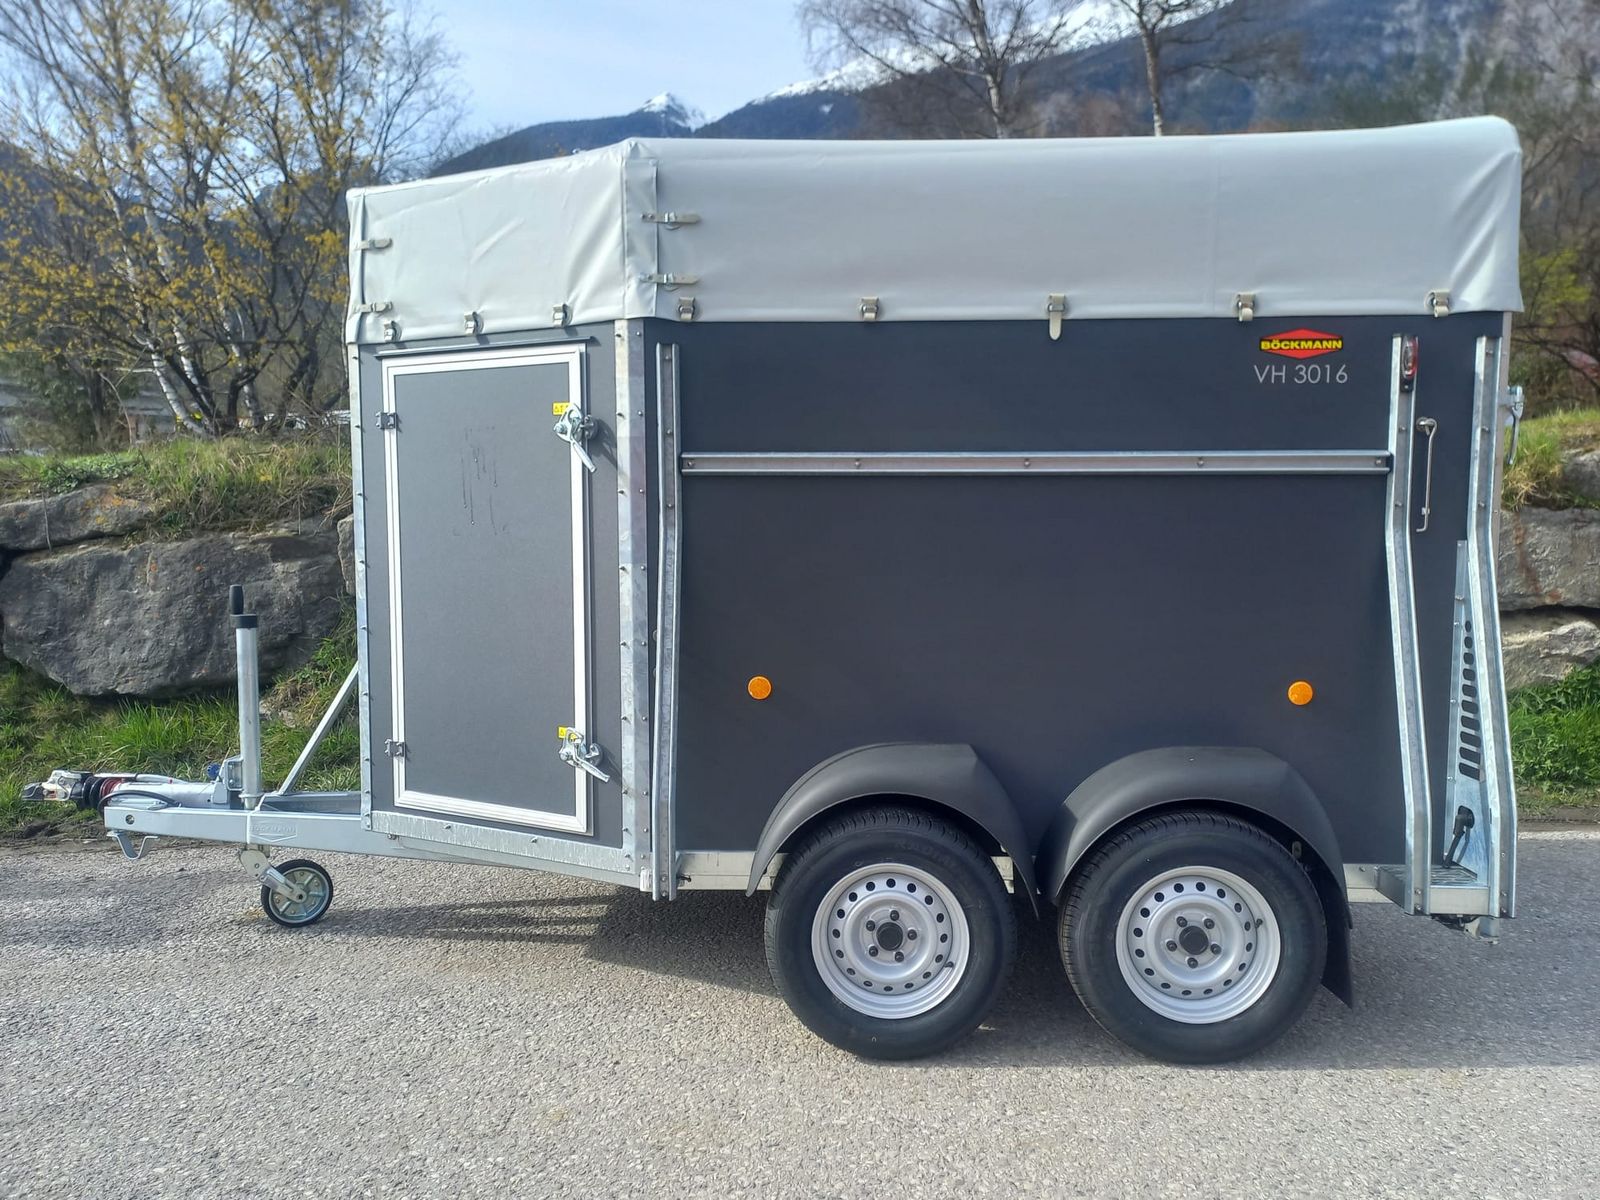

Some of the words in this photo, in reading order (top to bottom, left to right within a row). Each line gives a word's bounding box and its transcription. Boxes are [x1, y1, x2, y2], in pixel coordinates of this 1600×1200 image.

[1260, 339, 1342, 350] BÖCKMANN
[1253, 364, 1286, 384] VH
[1294, 364, 1348, 384] 3016
